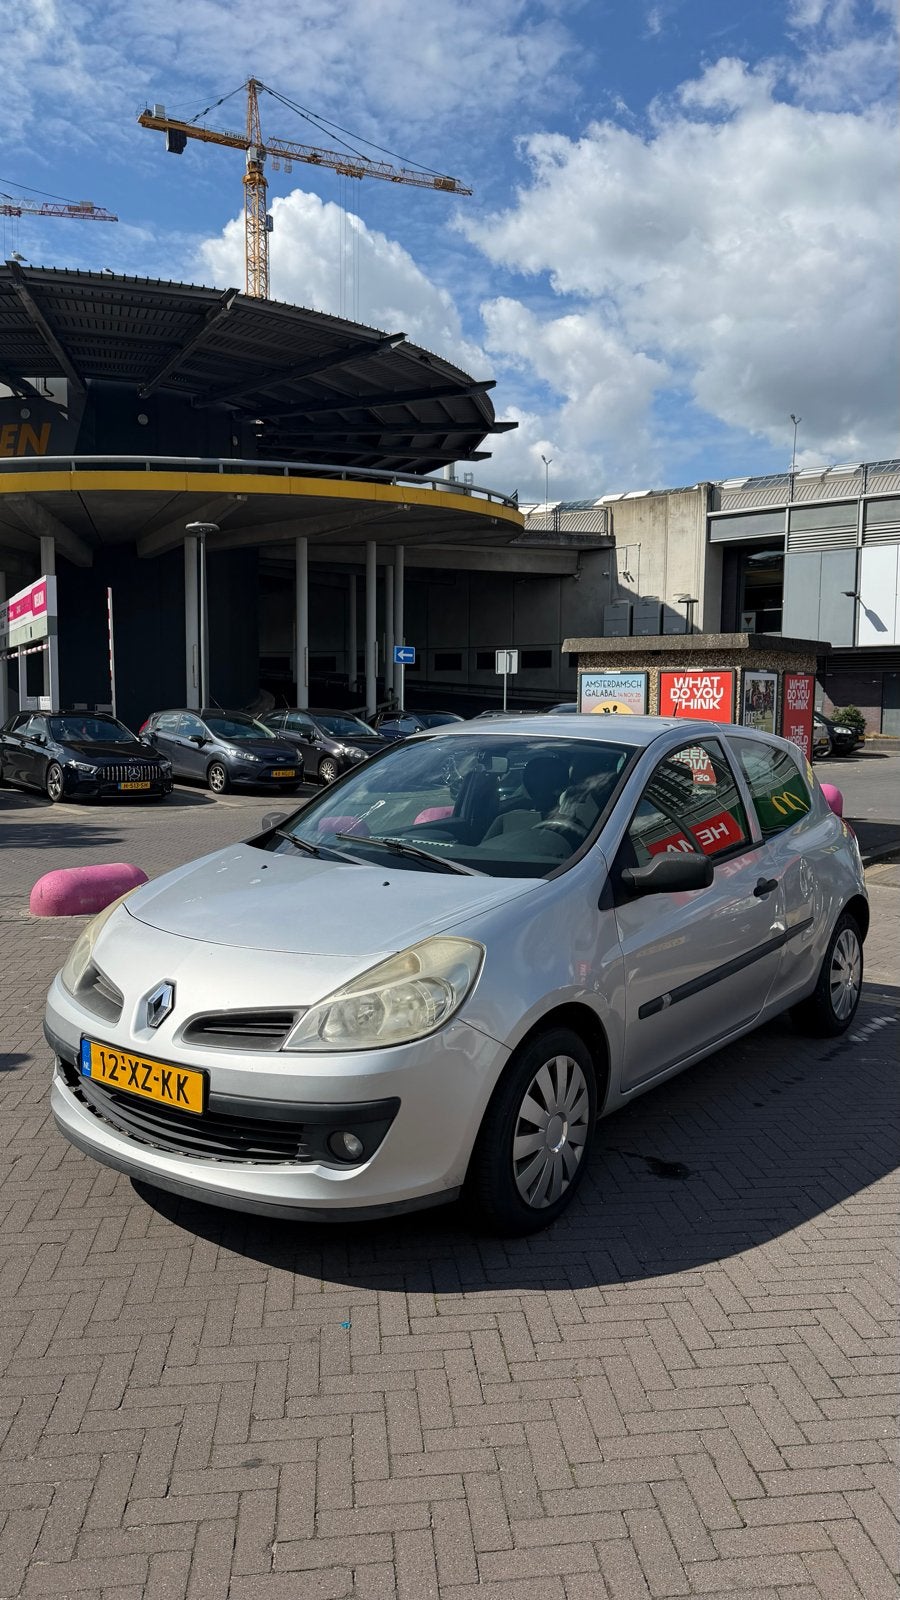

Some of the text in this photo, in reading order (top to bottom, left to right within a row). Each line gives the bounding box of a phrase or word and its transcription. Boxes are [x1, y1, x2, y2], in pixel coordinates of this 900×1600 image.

[585, 679, 642, 689] AMSTERDAMSCH
[673, 676, 721, 688] WHAT
[789, 679, 809, 690] WHAT
[585, 689, 617, 698] GALABAL
[670, 687, 724, 699] DO YOU
[787, 689, 810, 700] DO YOU
[672, 698, 721, 710] THINK
[788, 700, 809, 710] THINK
[790, 725, 804, 735] THE
[99, 1051, 190, 1105] 12-XZ-KK
